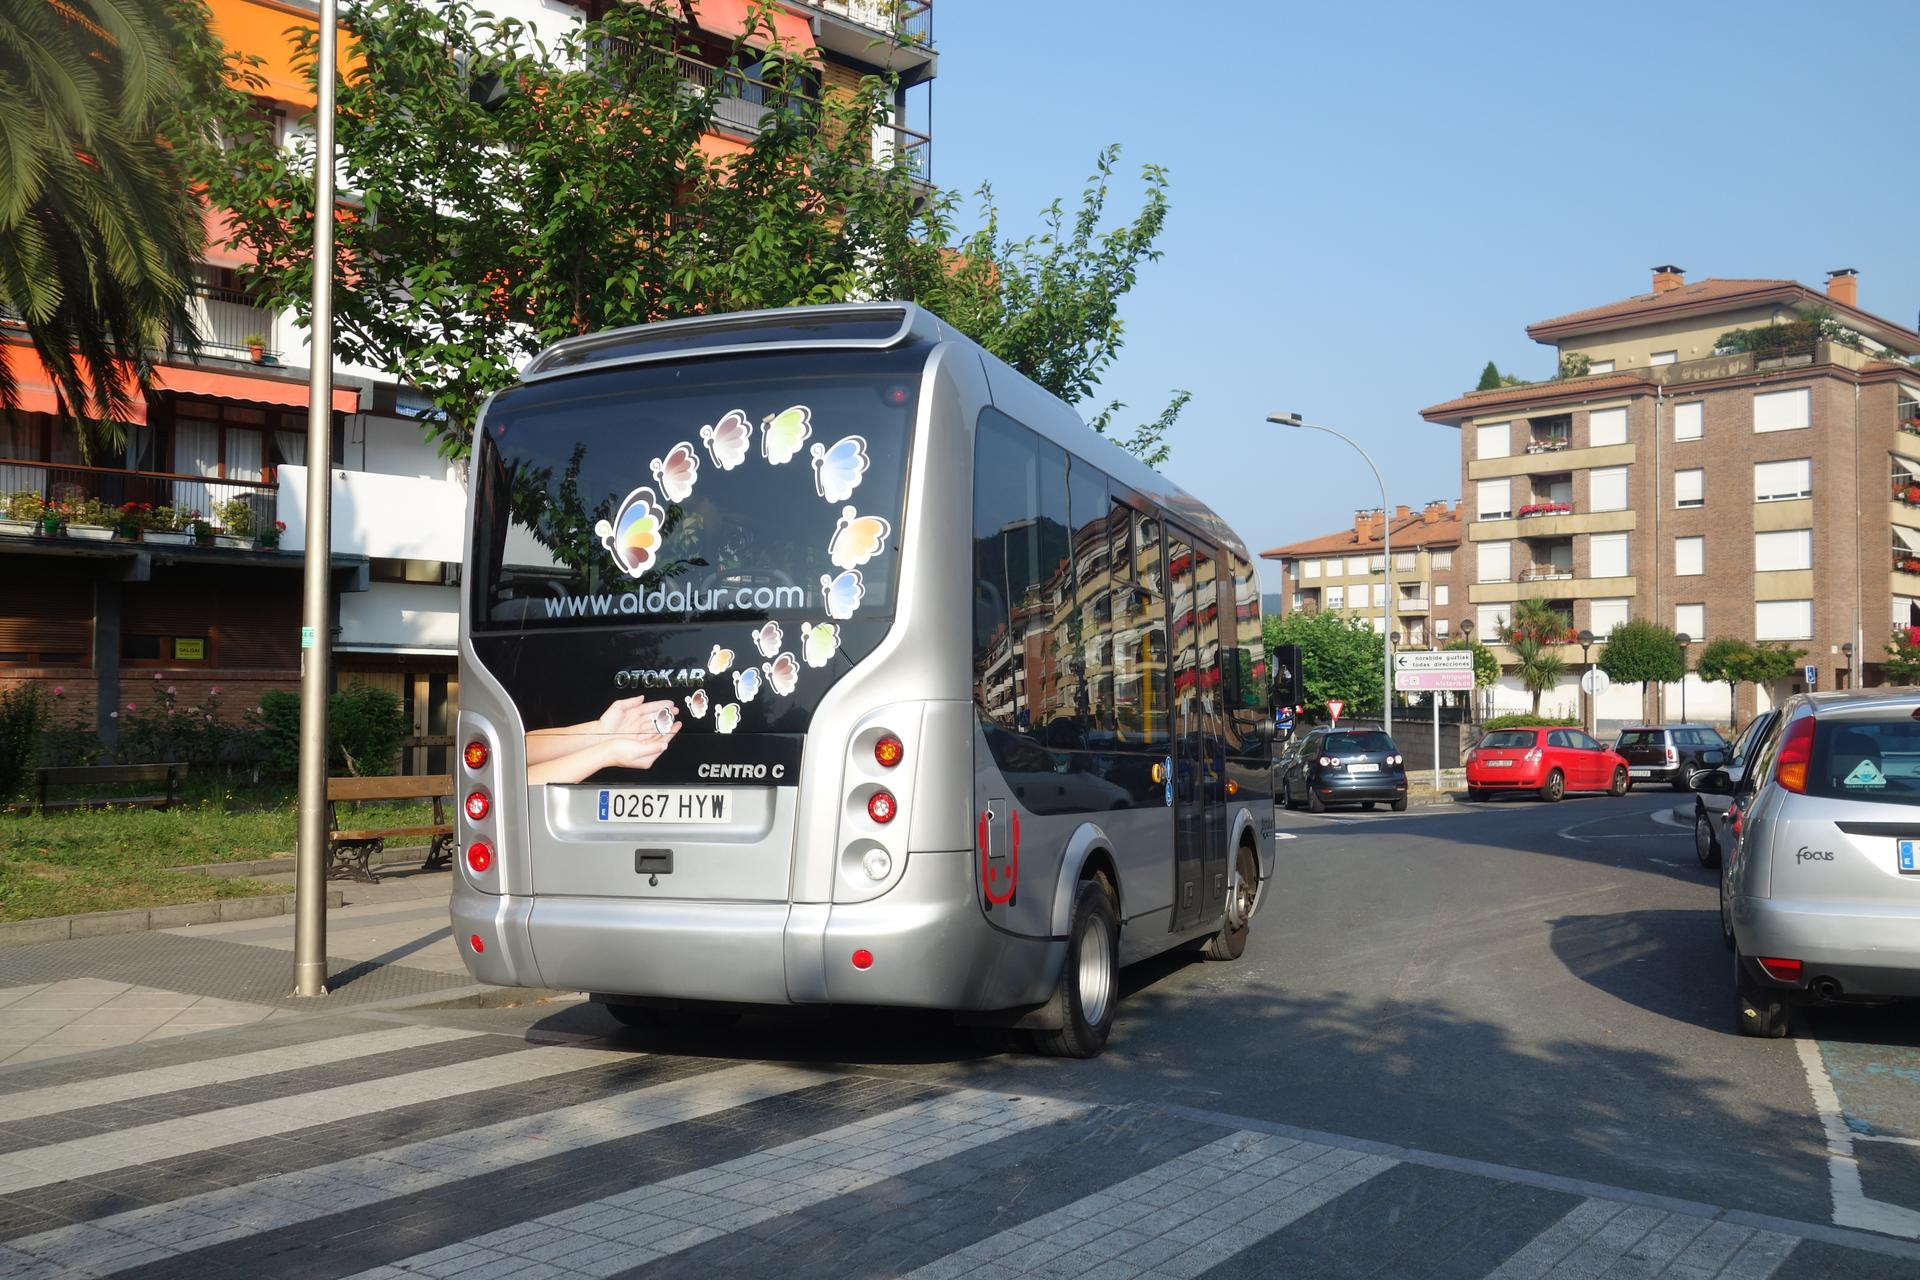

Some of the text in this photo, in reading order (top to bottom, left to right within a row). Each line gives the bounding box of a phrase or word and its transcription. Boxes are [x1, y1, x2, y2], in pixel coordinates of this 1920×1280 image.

[544, 581, 804, 618] www.aldalur.com
[614, 668, 706, 689] OTOKAR
[698, 763, 785, 779] CENTRO C
[613, 794, 670, 818] 0267
[679, 794, 724, 819] HYW
[1795, 846, 1834, 865] focus
[1904, 857, 1911, 865] E
